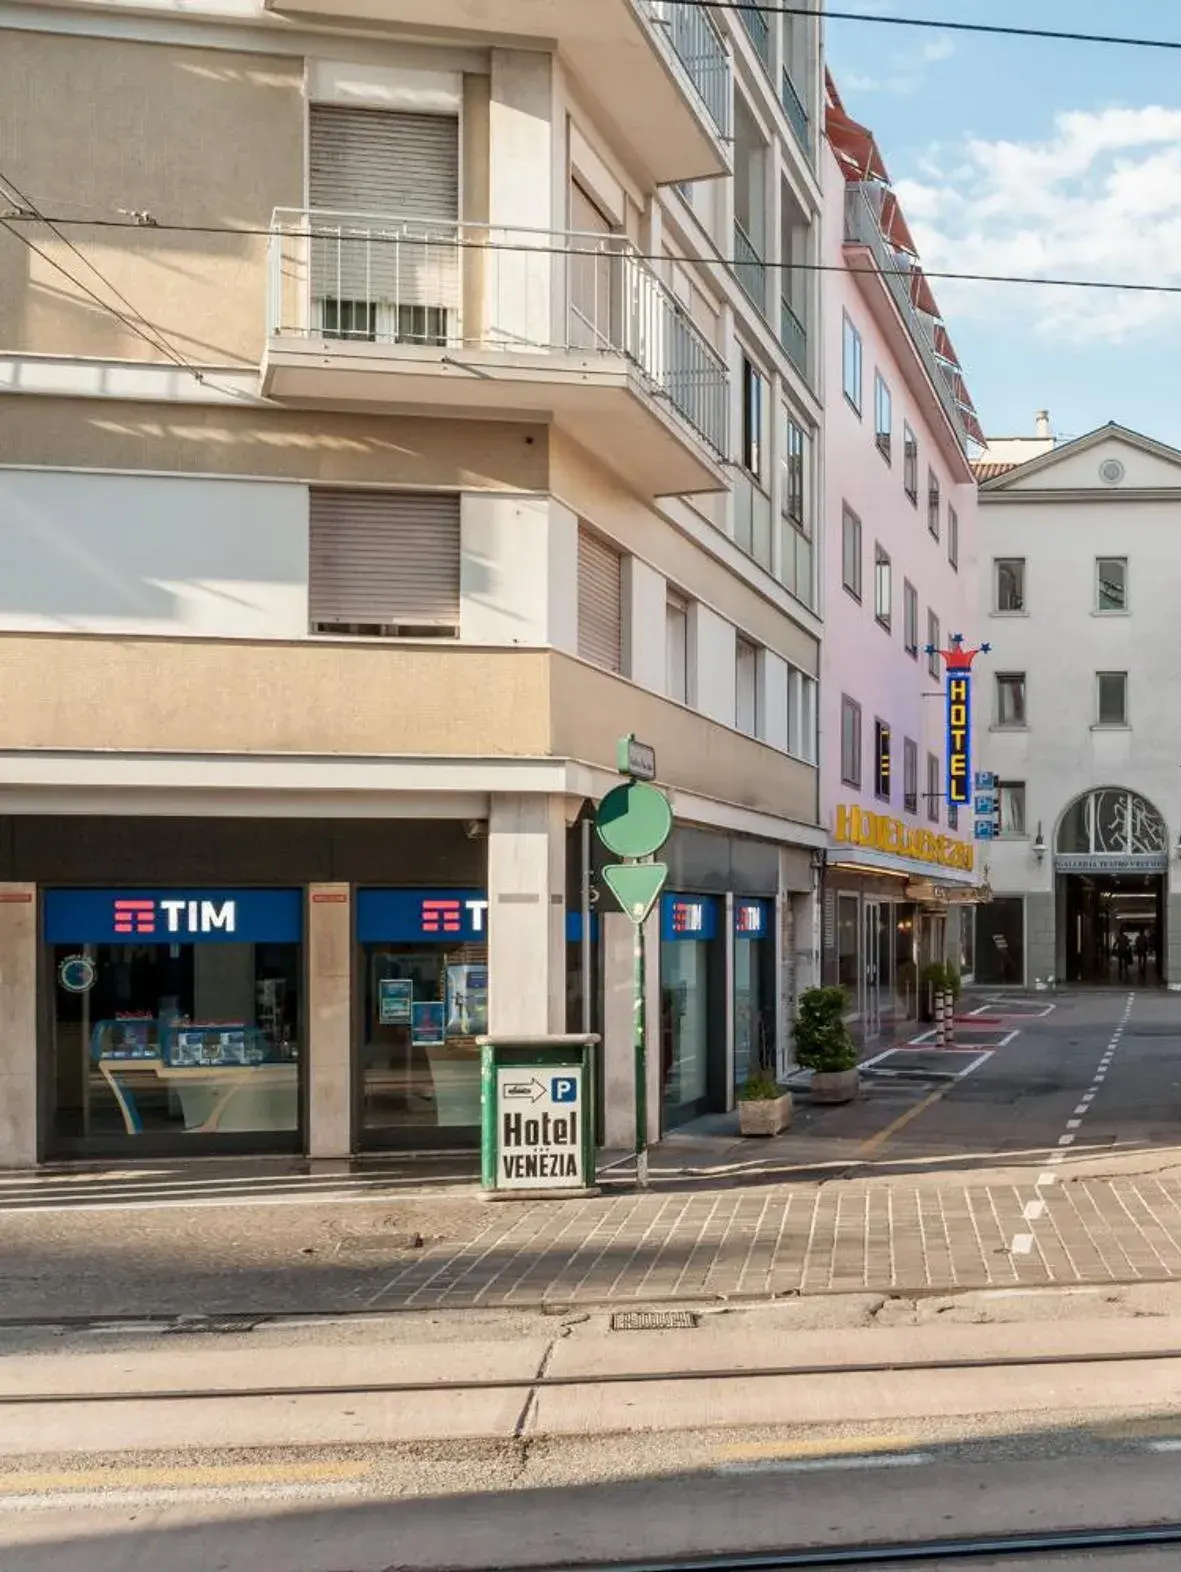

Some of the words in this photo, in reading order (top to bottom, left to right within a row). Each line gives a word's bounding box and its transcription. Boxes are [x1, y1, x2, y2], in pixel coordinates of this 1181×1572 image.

[951, 679, 967, 801] HOTEL
[160, 900, 237, 933] TIM
[557, 1080, 571, 1100] P
[503, 1111, 577, 1147] Hotel
[503, 1153, 578, 1179] VENEZIA
